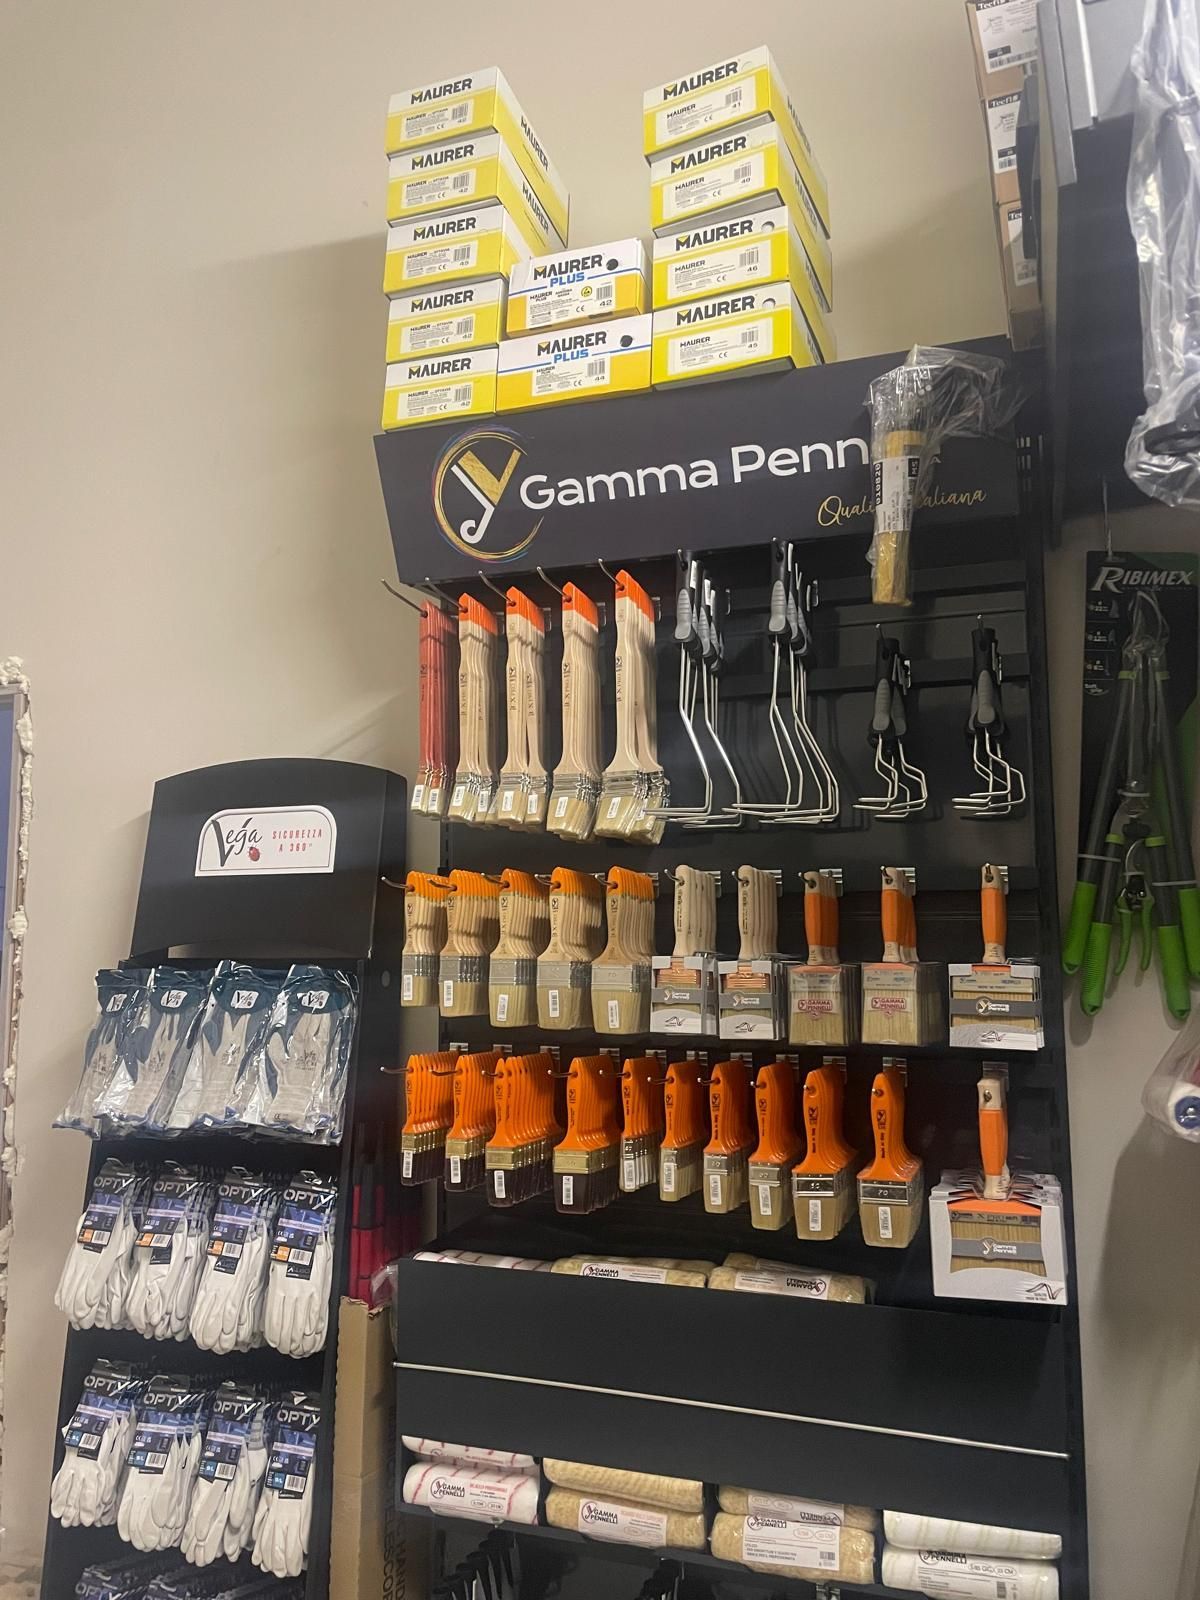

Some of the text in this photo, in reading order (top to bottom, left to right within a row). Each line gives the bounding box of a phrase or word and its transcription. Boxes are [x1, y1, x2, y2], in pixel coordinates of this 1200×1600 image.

[410, 78, 473, 105] MAURER
[663, 61, 739, 101] MAURER
[666, 103, 696, 119] MAURER
[520, 115, 549, 173] MAURER
[670, 135, 747, 174] MAURER
[411, 144, 475, 171] MAURER
[675, 177, 705, 191] MAURER
[413, 217, 477, 241] MAURER
[675, 219, 754, 251] MAURER
[533, 254, 603, 281] MAURER
[674, 259, 706, 273] MAURER
[550, 272, 585, 287] PLUS
[410, 289, 474, 313] MAURER
[599, 299, 612, 307] 42
[676, 295, 755, 326] MAURER
[537, 331, 608, 356] MAURER
[679, 336, 711, 348] MAURER
[553, 348, 589, 364] PLUS
[408, 358, 472, 379] MAURER
[519, 437, 869, 510] Gamma Penn
[817, 494, 876, 527] Quali
[915, 486, 987, 508] aliana
[1090, 566, 1194, 594] RIBIMEX
[272, 829, 323, 840] SICUREZZA
[278, 843, 283, 852] A
[218, 1185, 264, 1204] OPTY
[283, 1189, 335, 1210] OPTY
[83, 1375, 131, 1397] OPTY
[143, 1393, 191, 1412] OPTY
[213, 1401, 257, 1421] OPTY
[277, 1409, 320, 1431] OPTY
[439, 1489, 465, 1498] PENNELLI
[442, 1482, 465, 1492] GAMMA
[590, 1514, 618, 1524] PENNELLI
[593, 1508, 618, 1519] GAMMA
[930, 1555, 967, 1564] PENNELLI
